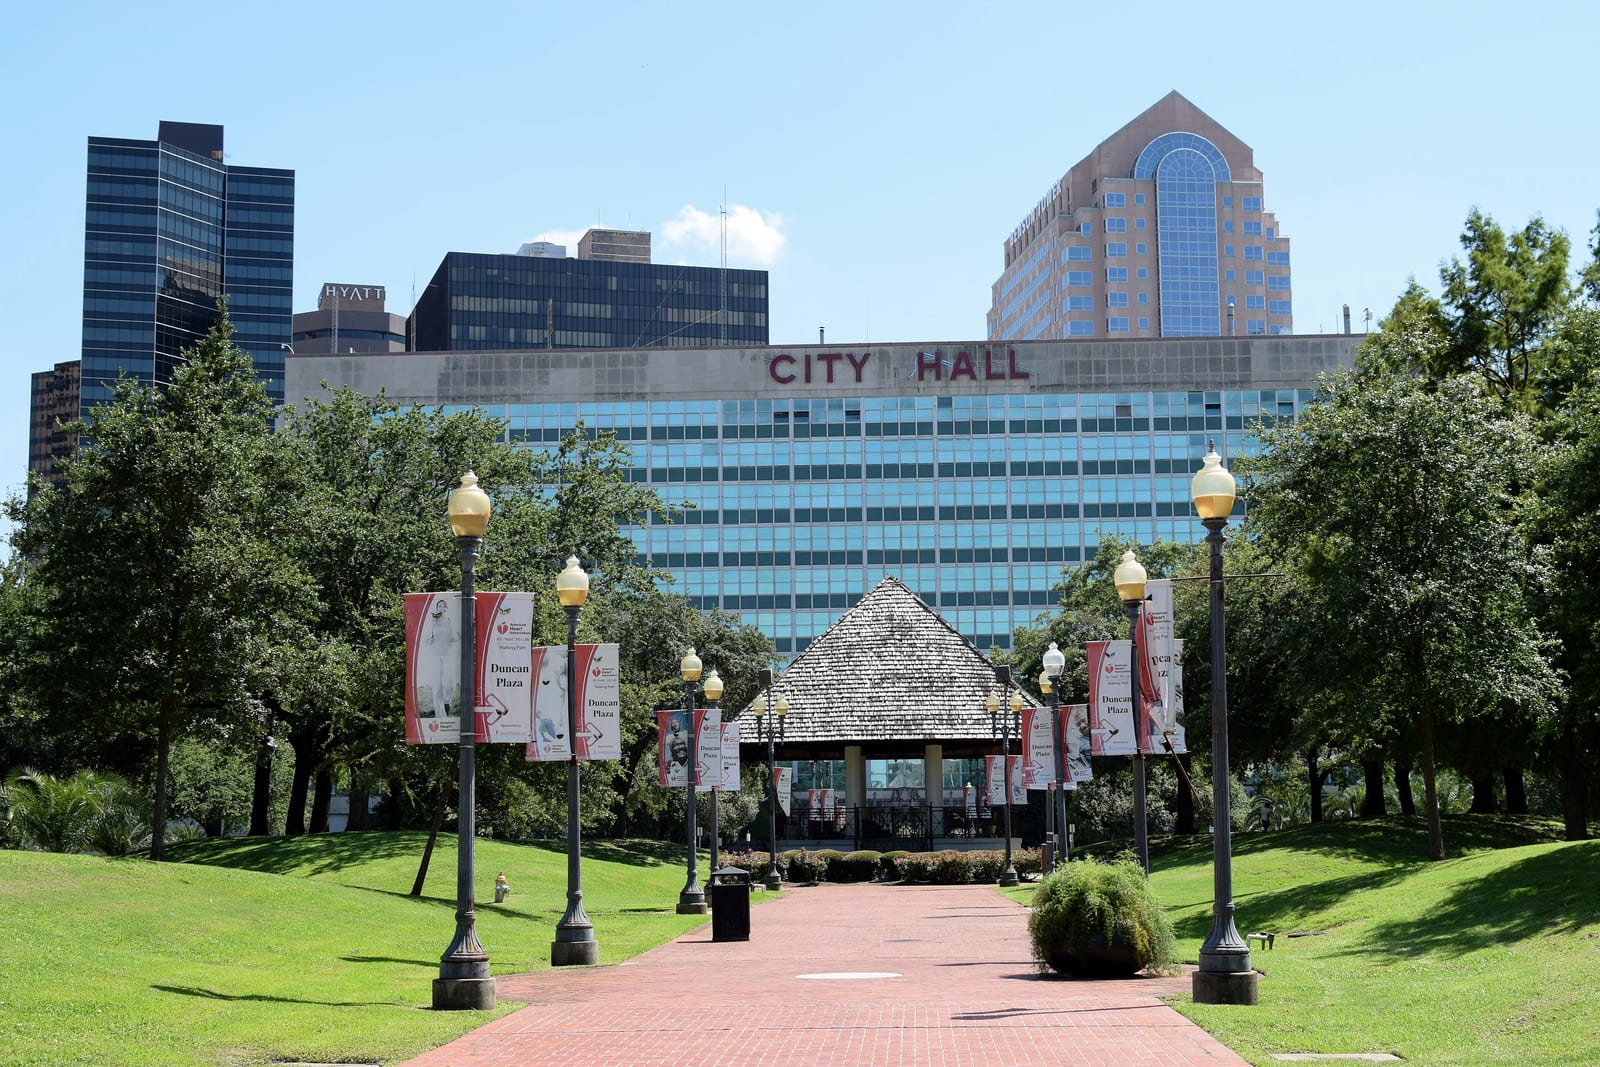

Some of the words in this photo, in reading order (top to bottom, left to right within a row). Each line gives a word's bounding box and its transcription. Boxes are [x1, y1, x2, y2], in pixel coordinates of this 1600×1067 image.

[326, 286, 383, 301] HYATT
[769, 352, 871, 384] CITY
[917, 350, 1030, 381] HALL
[491, 663, 529, 673] Duncan
[496, 677, 523, 688] Plaza
[588, 699, 618, 707] Duncan
[1102, 695, 1133, 704] Duncan
[593, 710, 614, 718] Plaza
[1107, 706, 1129, 714] Plaza
